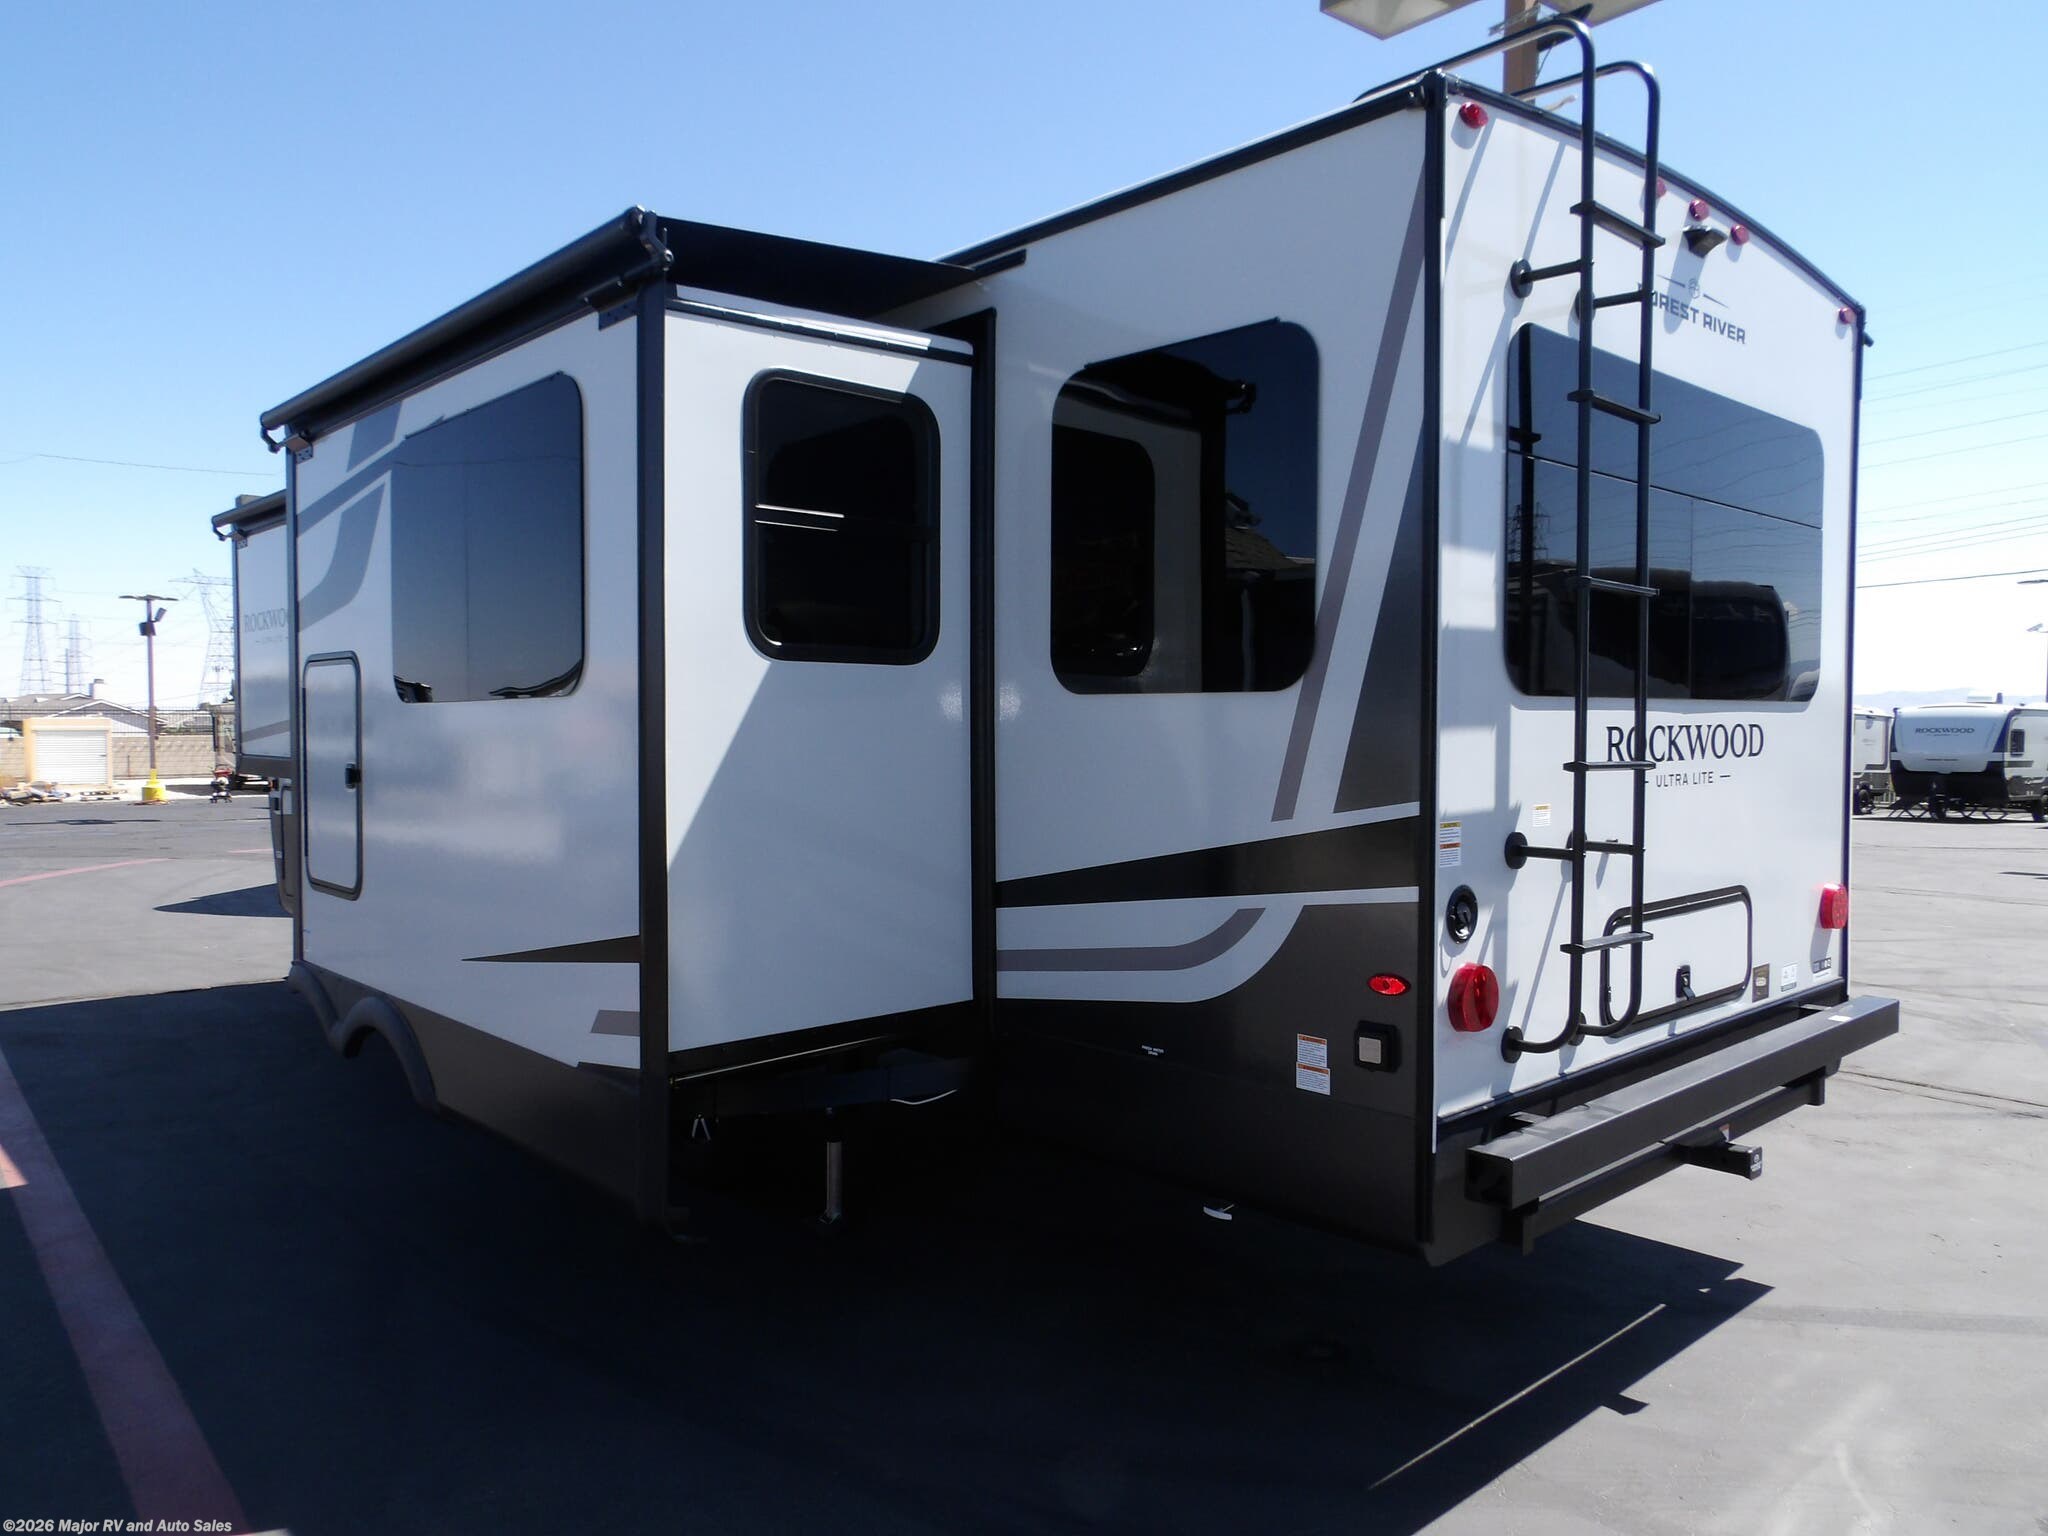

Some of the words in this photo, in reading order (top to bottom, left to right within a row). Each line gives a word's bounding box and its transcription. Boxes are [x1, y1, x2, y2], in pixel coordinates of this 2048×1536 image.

[1702, 312, 1746, 345] RIVER
[243, 608, 289, 633] ROCKWO
[1915, 727, 1975, 735] ROCKWOOD
[1656, 773, 1689, 788] ULTRA
[1692, 771, 1714, 785] LITE
